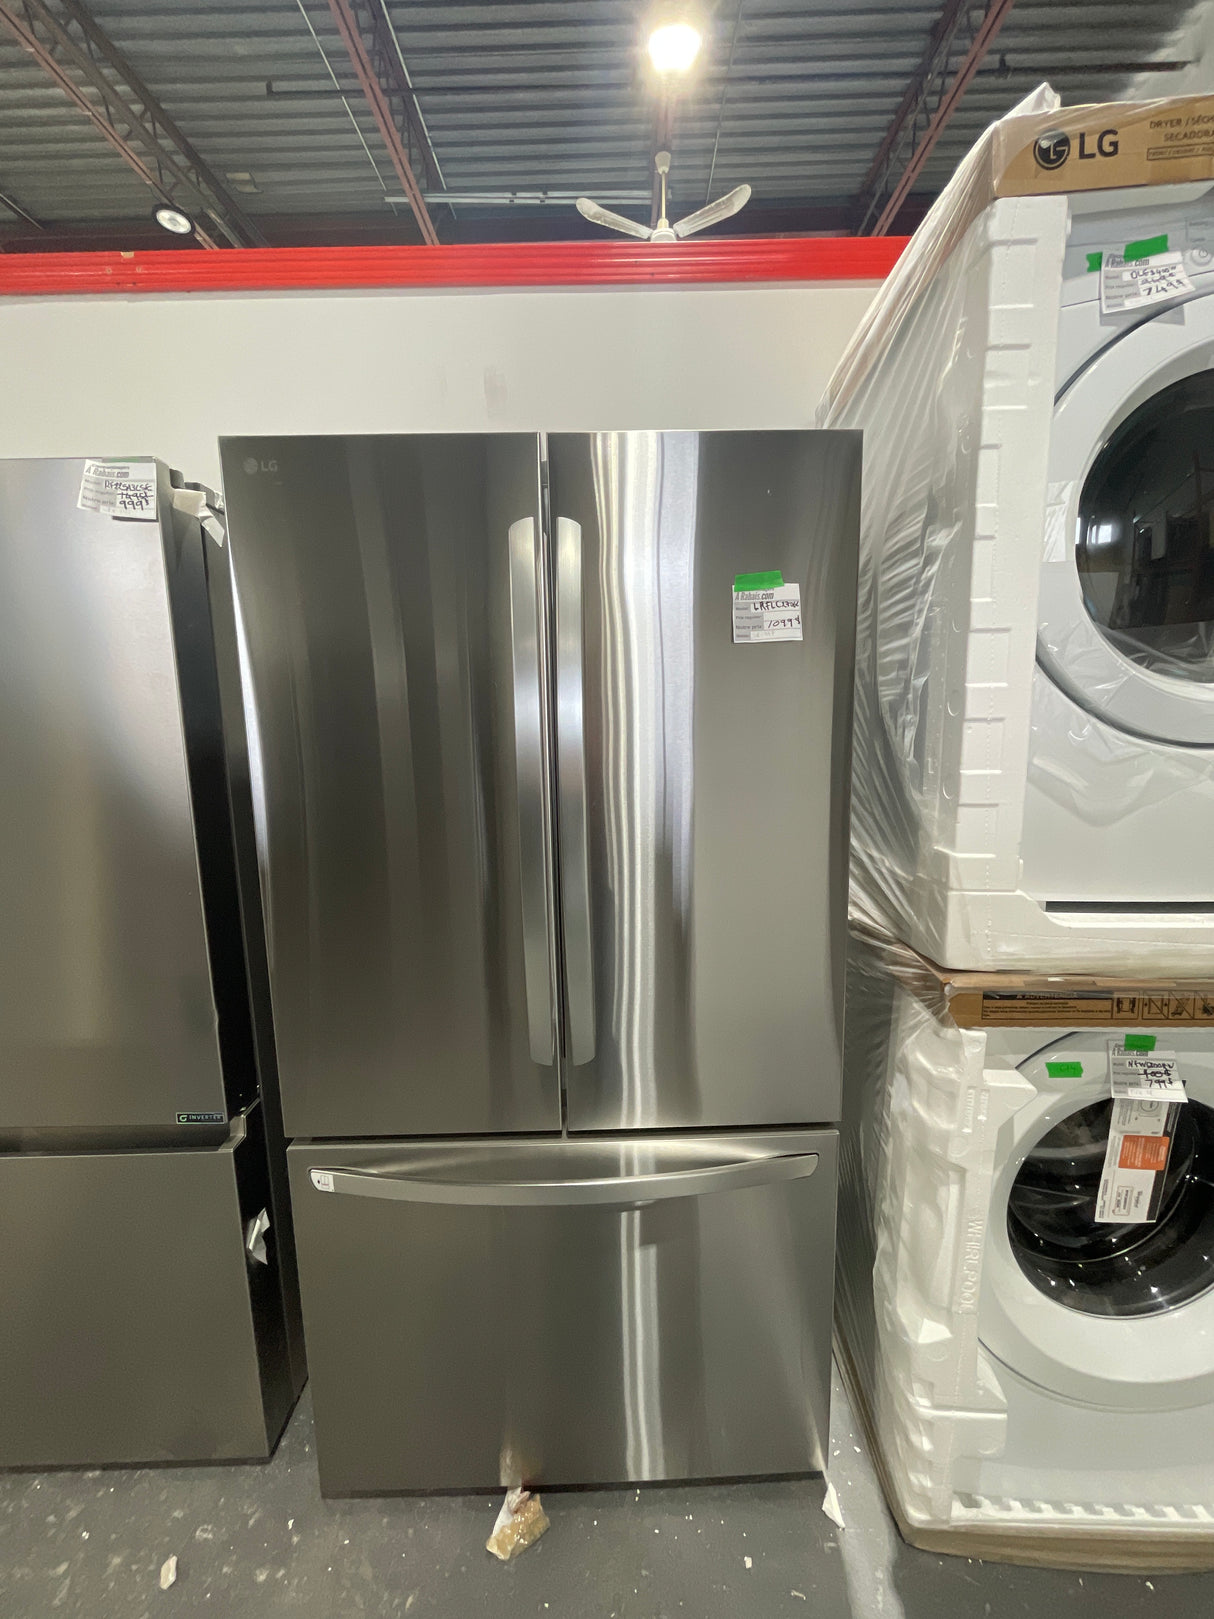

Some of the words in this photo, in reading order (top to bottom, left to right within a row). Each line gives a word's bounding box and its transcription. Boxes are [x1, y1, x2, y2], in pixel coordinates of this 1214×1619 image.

[1149, 118, 1182, 129] DRYER
[1078, 128, 1119, 160] LG
[261, 459, 278, 472] LG
